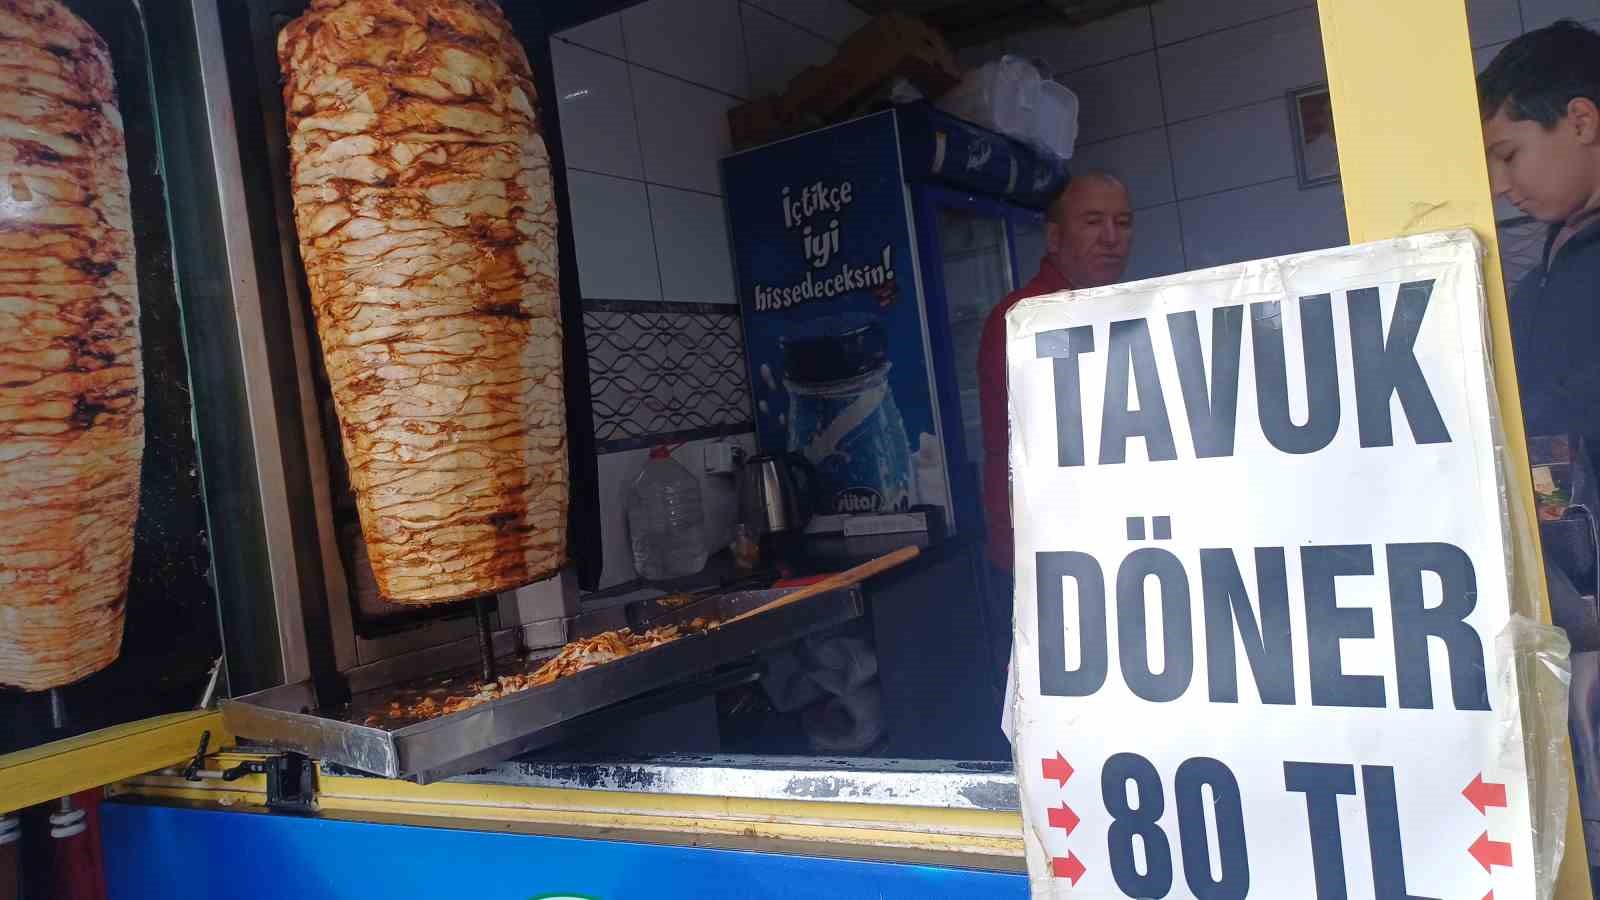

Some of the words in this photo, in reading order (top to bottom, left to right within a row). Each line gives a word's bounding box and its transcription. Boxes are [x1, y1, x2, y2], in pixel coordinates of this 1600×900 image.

[782, 181, 852, 228] İçtikçe
[803, 219, 839, 267] iyi
[755, 245, 894, 311] hissedeceksin!
[1035, 278, 1453, 467] TAVUK
[1035, 515, 1492, 711] DÖNER
[1101, 752, 1250, 900] 80
[1283, 760, 1444, 900] TL
